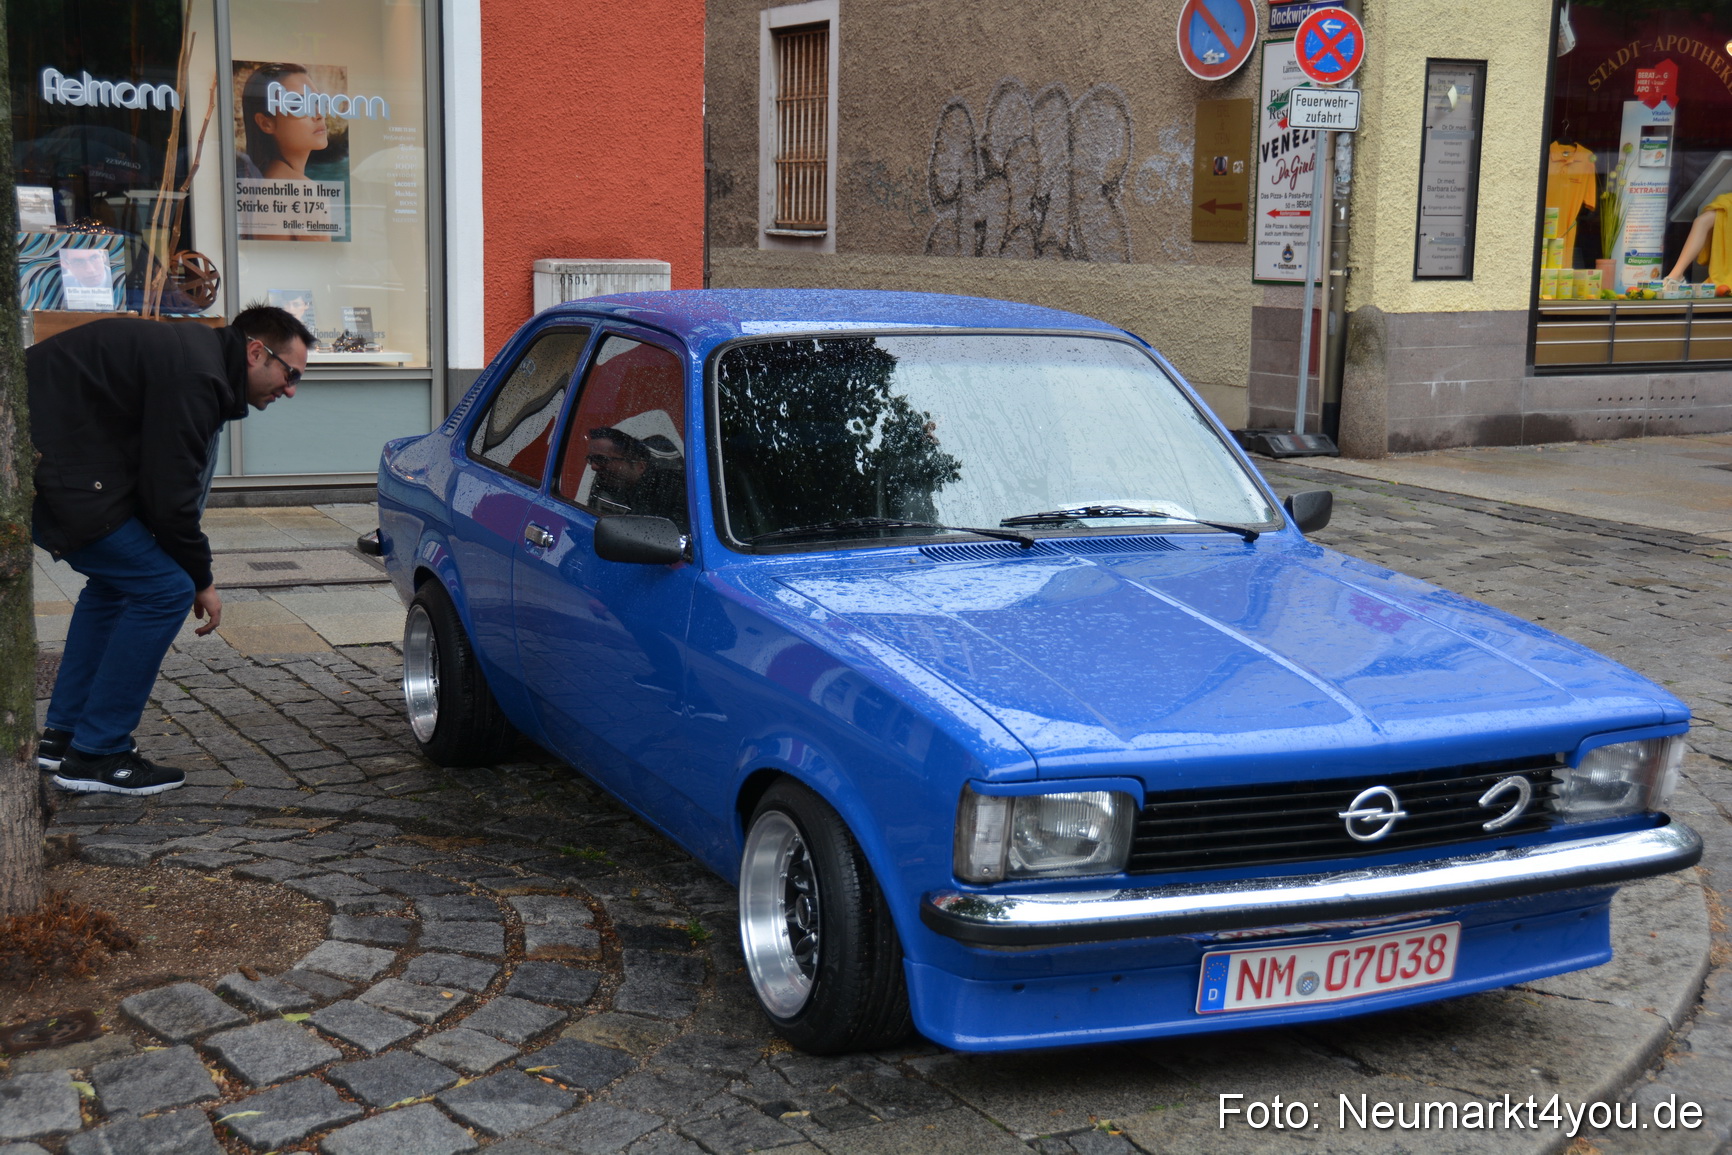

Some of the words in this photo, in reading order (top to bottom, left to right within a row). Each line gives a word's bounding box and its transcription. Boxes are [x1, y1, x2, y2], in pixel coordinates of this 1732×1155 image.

[43, 68, 180, 111] Fielmann
[1270, 90, 1290, 103] Pizz
[268, 82, 389, 120] Fielmann
[1296, 94, 1354, 108] Feuerwehr-
[1270, 107, 1289, 120] Rest
[1305, 111, 1343, 124] zufahrt
[1261, 129, 1318, 163] VENEZI
[236, 182, 300, 197] Sonnenbrille
[303, 184, 313, 197] in
[316, 184, 342, 198] Ihrer
[1427, 185, 1450, 193] Barbara
[1450, 185, 1466, 193] Löwe
[236, 200, 269, 213] Stärke
[272, 200, 288, 214] für
[292, 201, 301, 214] €
[283, 220, 304, 230] Brille:
[306, 221, 342, 232] Fielmann.
[1235, 954, 1297, 1001] NM
[1323, 932, 1448, 992] 07038
[1208, 988, 1218, 1001] D
